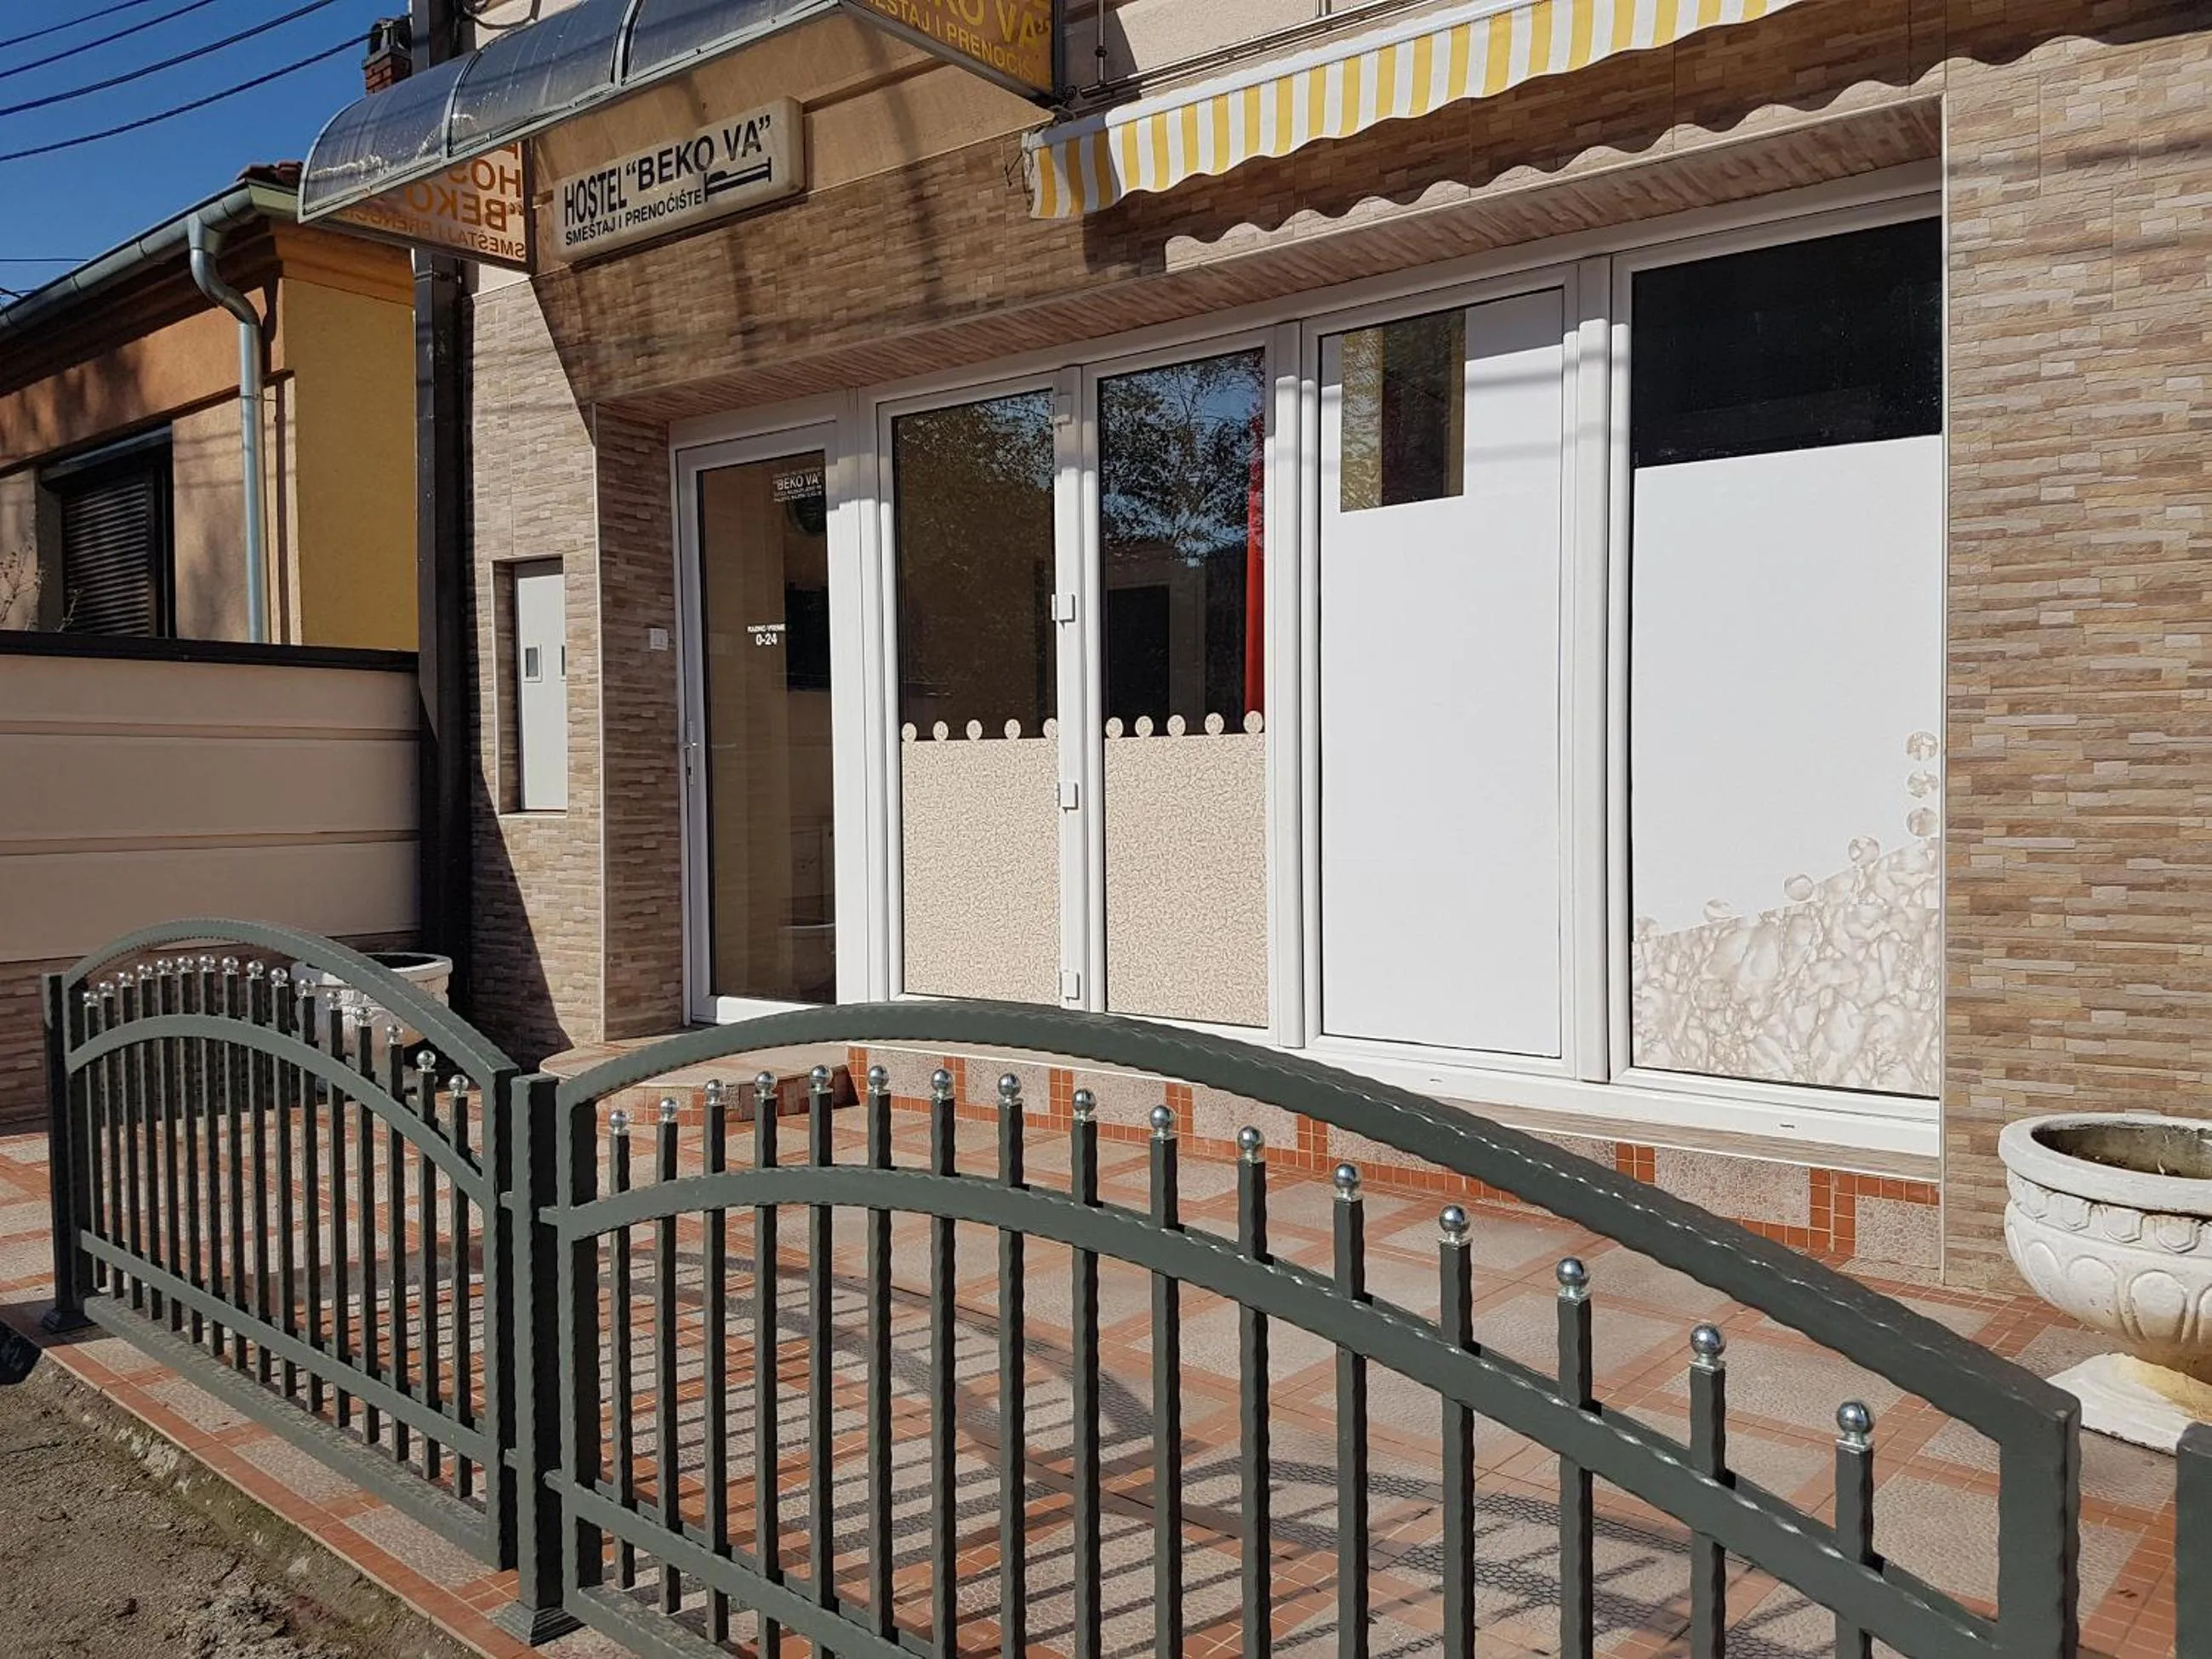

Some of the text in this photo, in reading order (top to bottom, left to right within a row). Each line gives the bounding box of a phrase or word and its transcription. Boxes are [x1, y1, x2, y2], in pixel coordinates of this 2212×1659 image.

[564, 114, 771, 227] HOSTEL “BEKO VA”
[565, 219, 616, 247] SMEŠTAJ
[624, 187, 702, 227] PRENOĆIŠTE
[755, 632, 778, 646] 0-24
